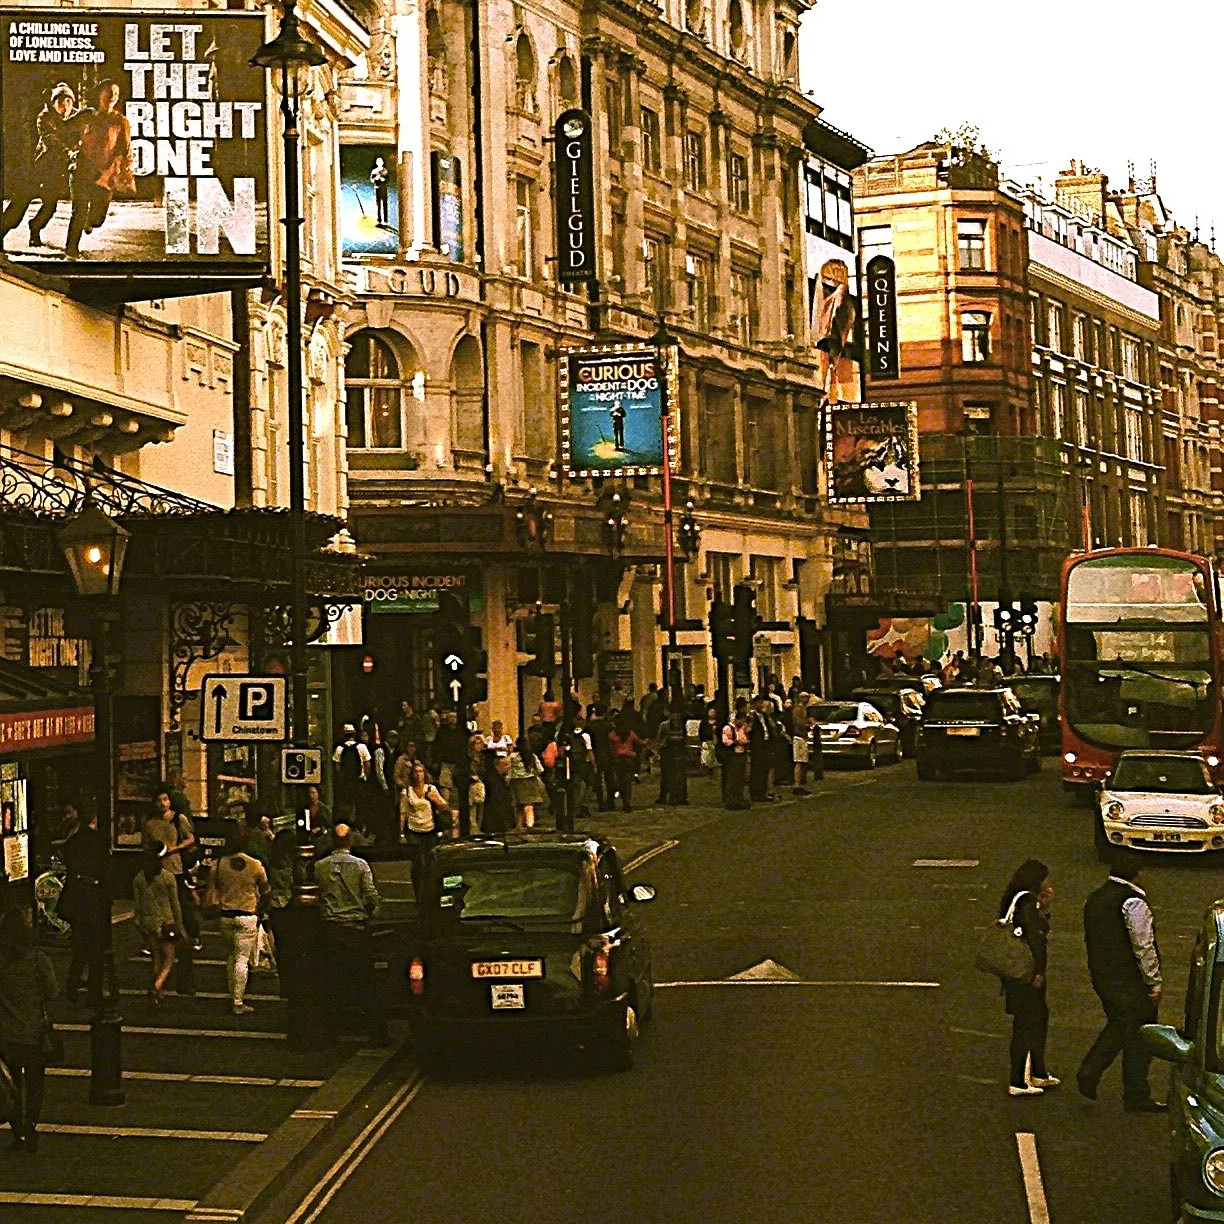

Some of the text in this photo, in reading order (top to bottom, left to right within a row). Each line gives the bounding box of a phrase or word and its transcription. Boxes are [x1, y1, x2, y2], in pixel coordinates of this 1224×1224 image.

[9, 22, 98, 36] A CHILLING TALE
[9, 36, 95, 50] OF LONELINESS,
[124, 24, 203, 61] LET
[9, 49, 105, 63] LOVE AND LEGEND
[124, 62, 211, 99] THE
[127, 102, 262, 139] RIGHT
[129, 140, 214, 176] ONE
[565, 141, 586, 267] GIELGUD
[164, 177, 256, 255] IN
[874, 278, 890, 370] QUEENS
[578, 363, 655, 382] CURIOUS
[577, 381, 621, 392] INCIDENT
[627, 377, 659, 391] DOG
[859, 412, 877, 424] Les
[358, 575, 409, 588] URIOUS
[364, 587, 398, 601] DOG
[247, 687, 268, 717] P
[232, 725, 279, 735] Chinatown
